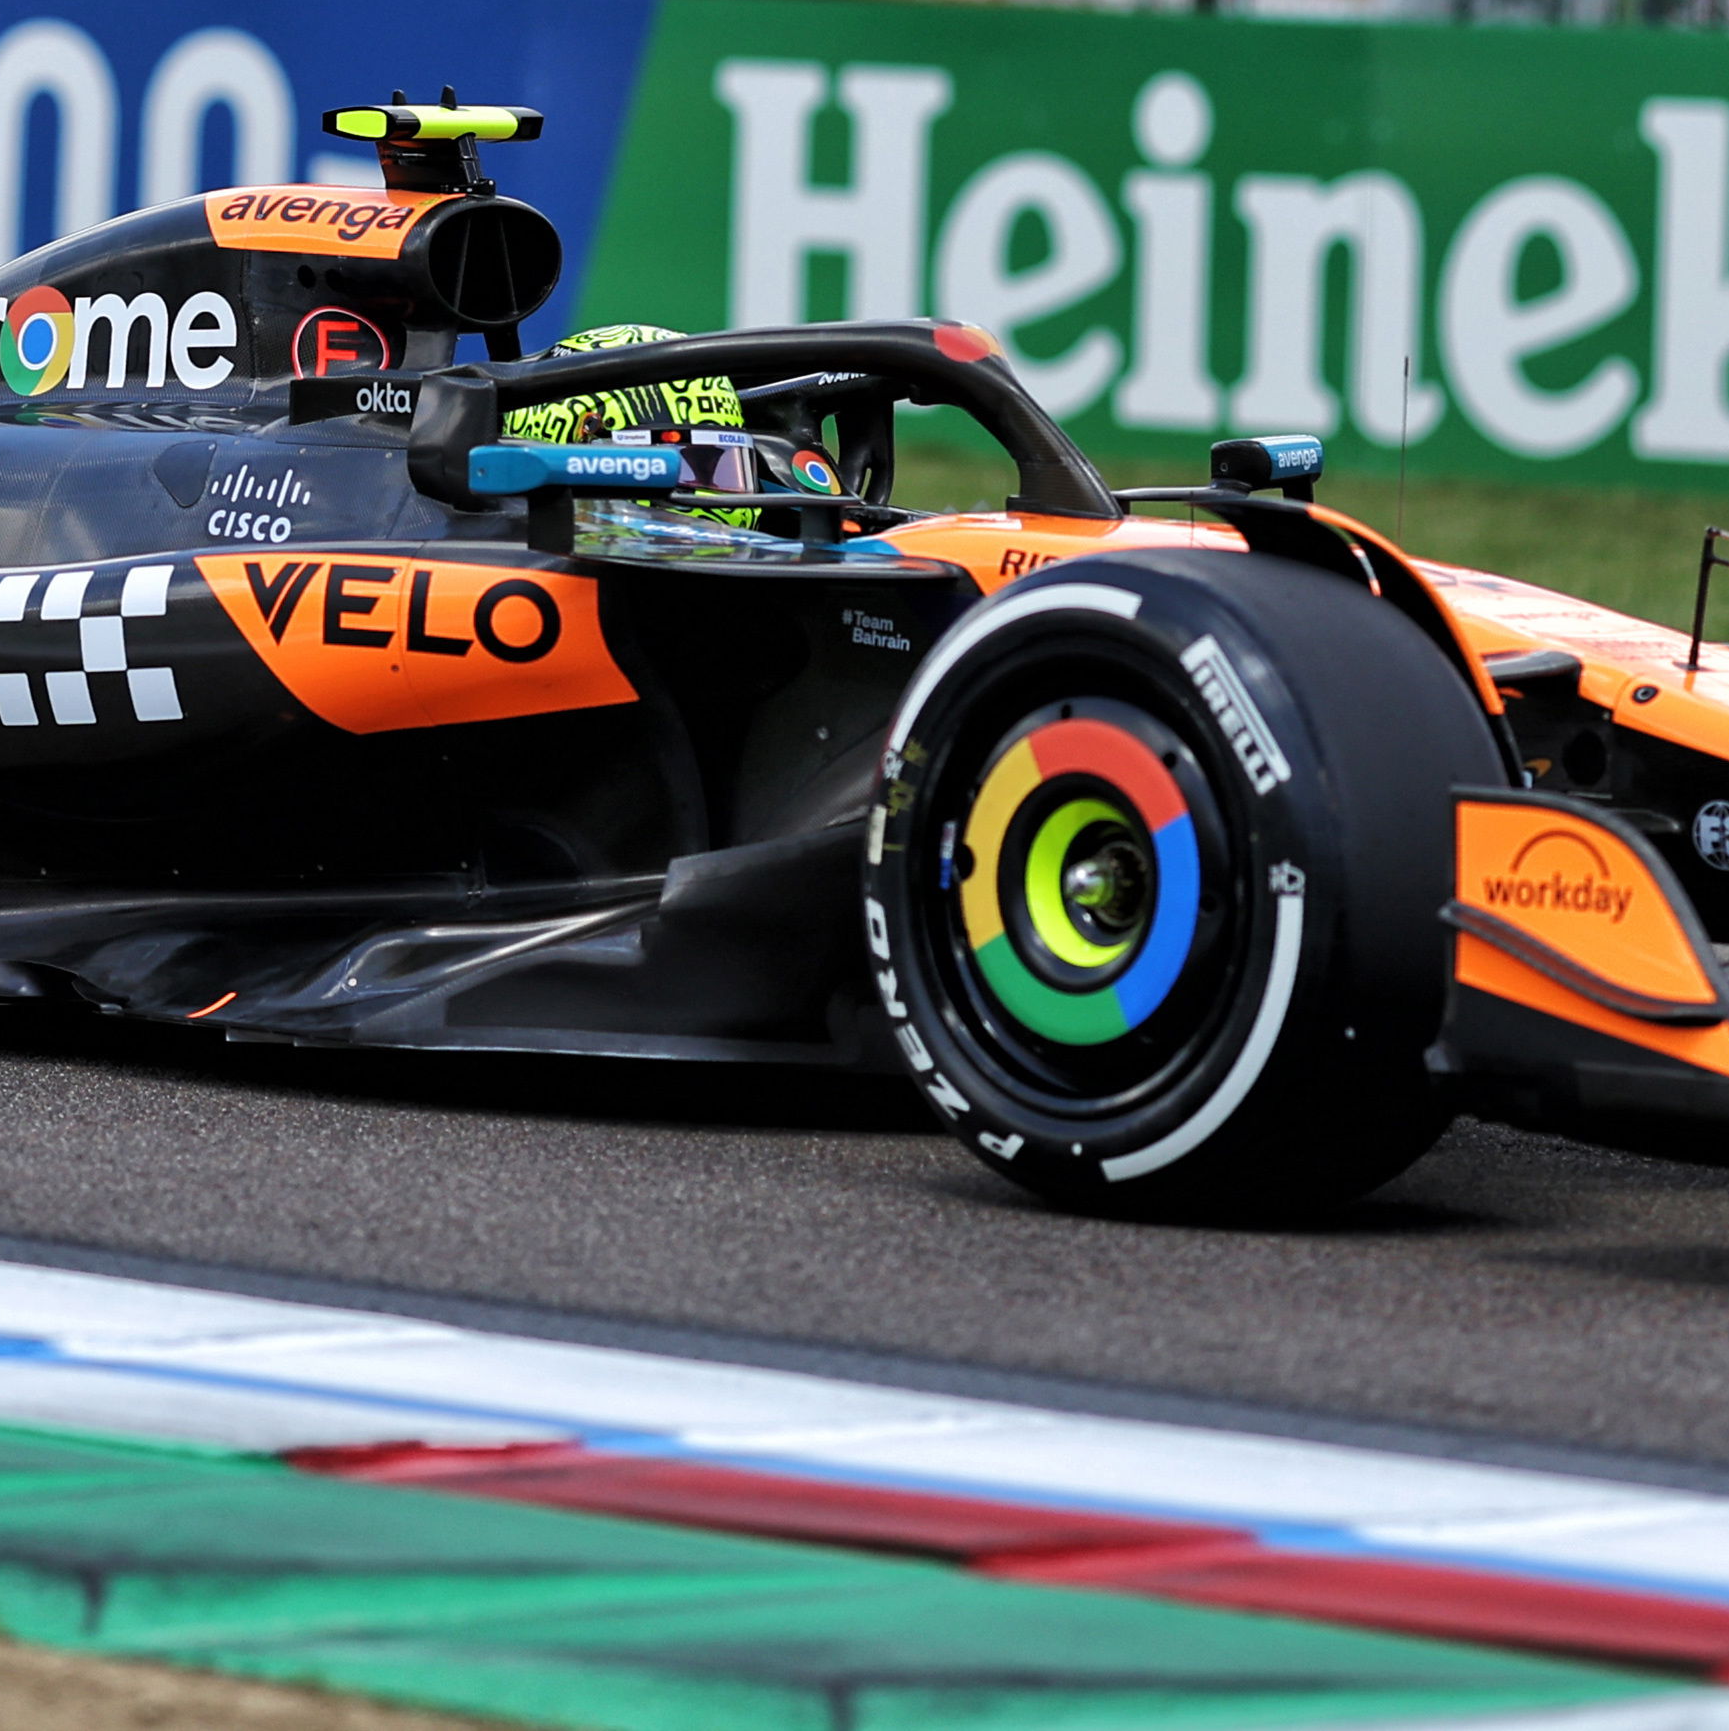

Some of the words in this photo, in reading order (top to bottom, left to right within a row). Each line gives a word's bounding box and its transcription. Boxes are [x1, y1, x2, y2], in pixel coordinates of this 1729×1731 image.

[220, 193, 414, 241] avenga
[356, 382, 412, 413] okta
[566, 455, 667, 480] avenga
[1278, 449, 1319, 470] avenga
[244, 561, 561, 663] VELO
[852, 627, 910, 651] Bahrain
[1179, 633, 1291, 796] PIRELLI
[1483, 872, 1633, 924] workday
[865, 896, 970, 1121] ZERO
[978, 1132, 1024, 1160] P
